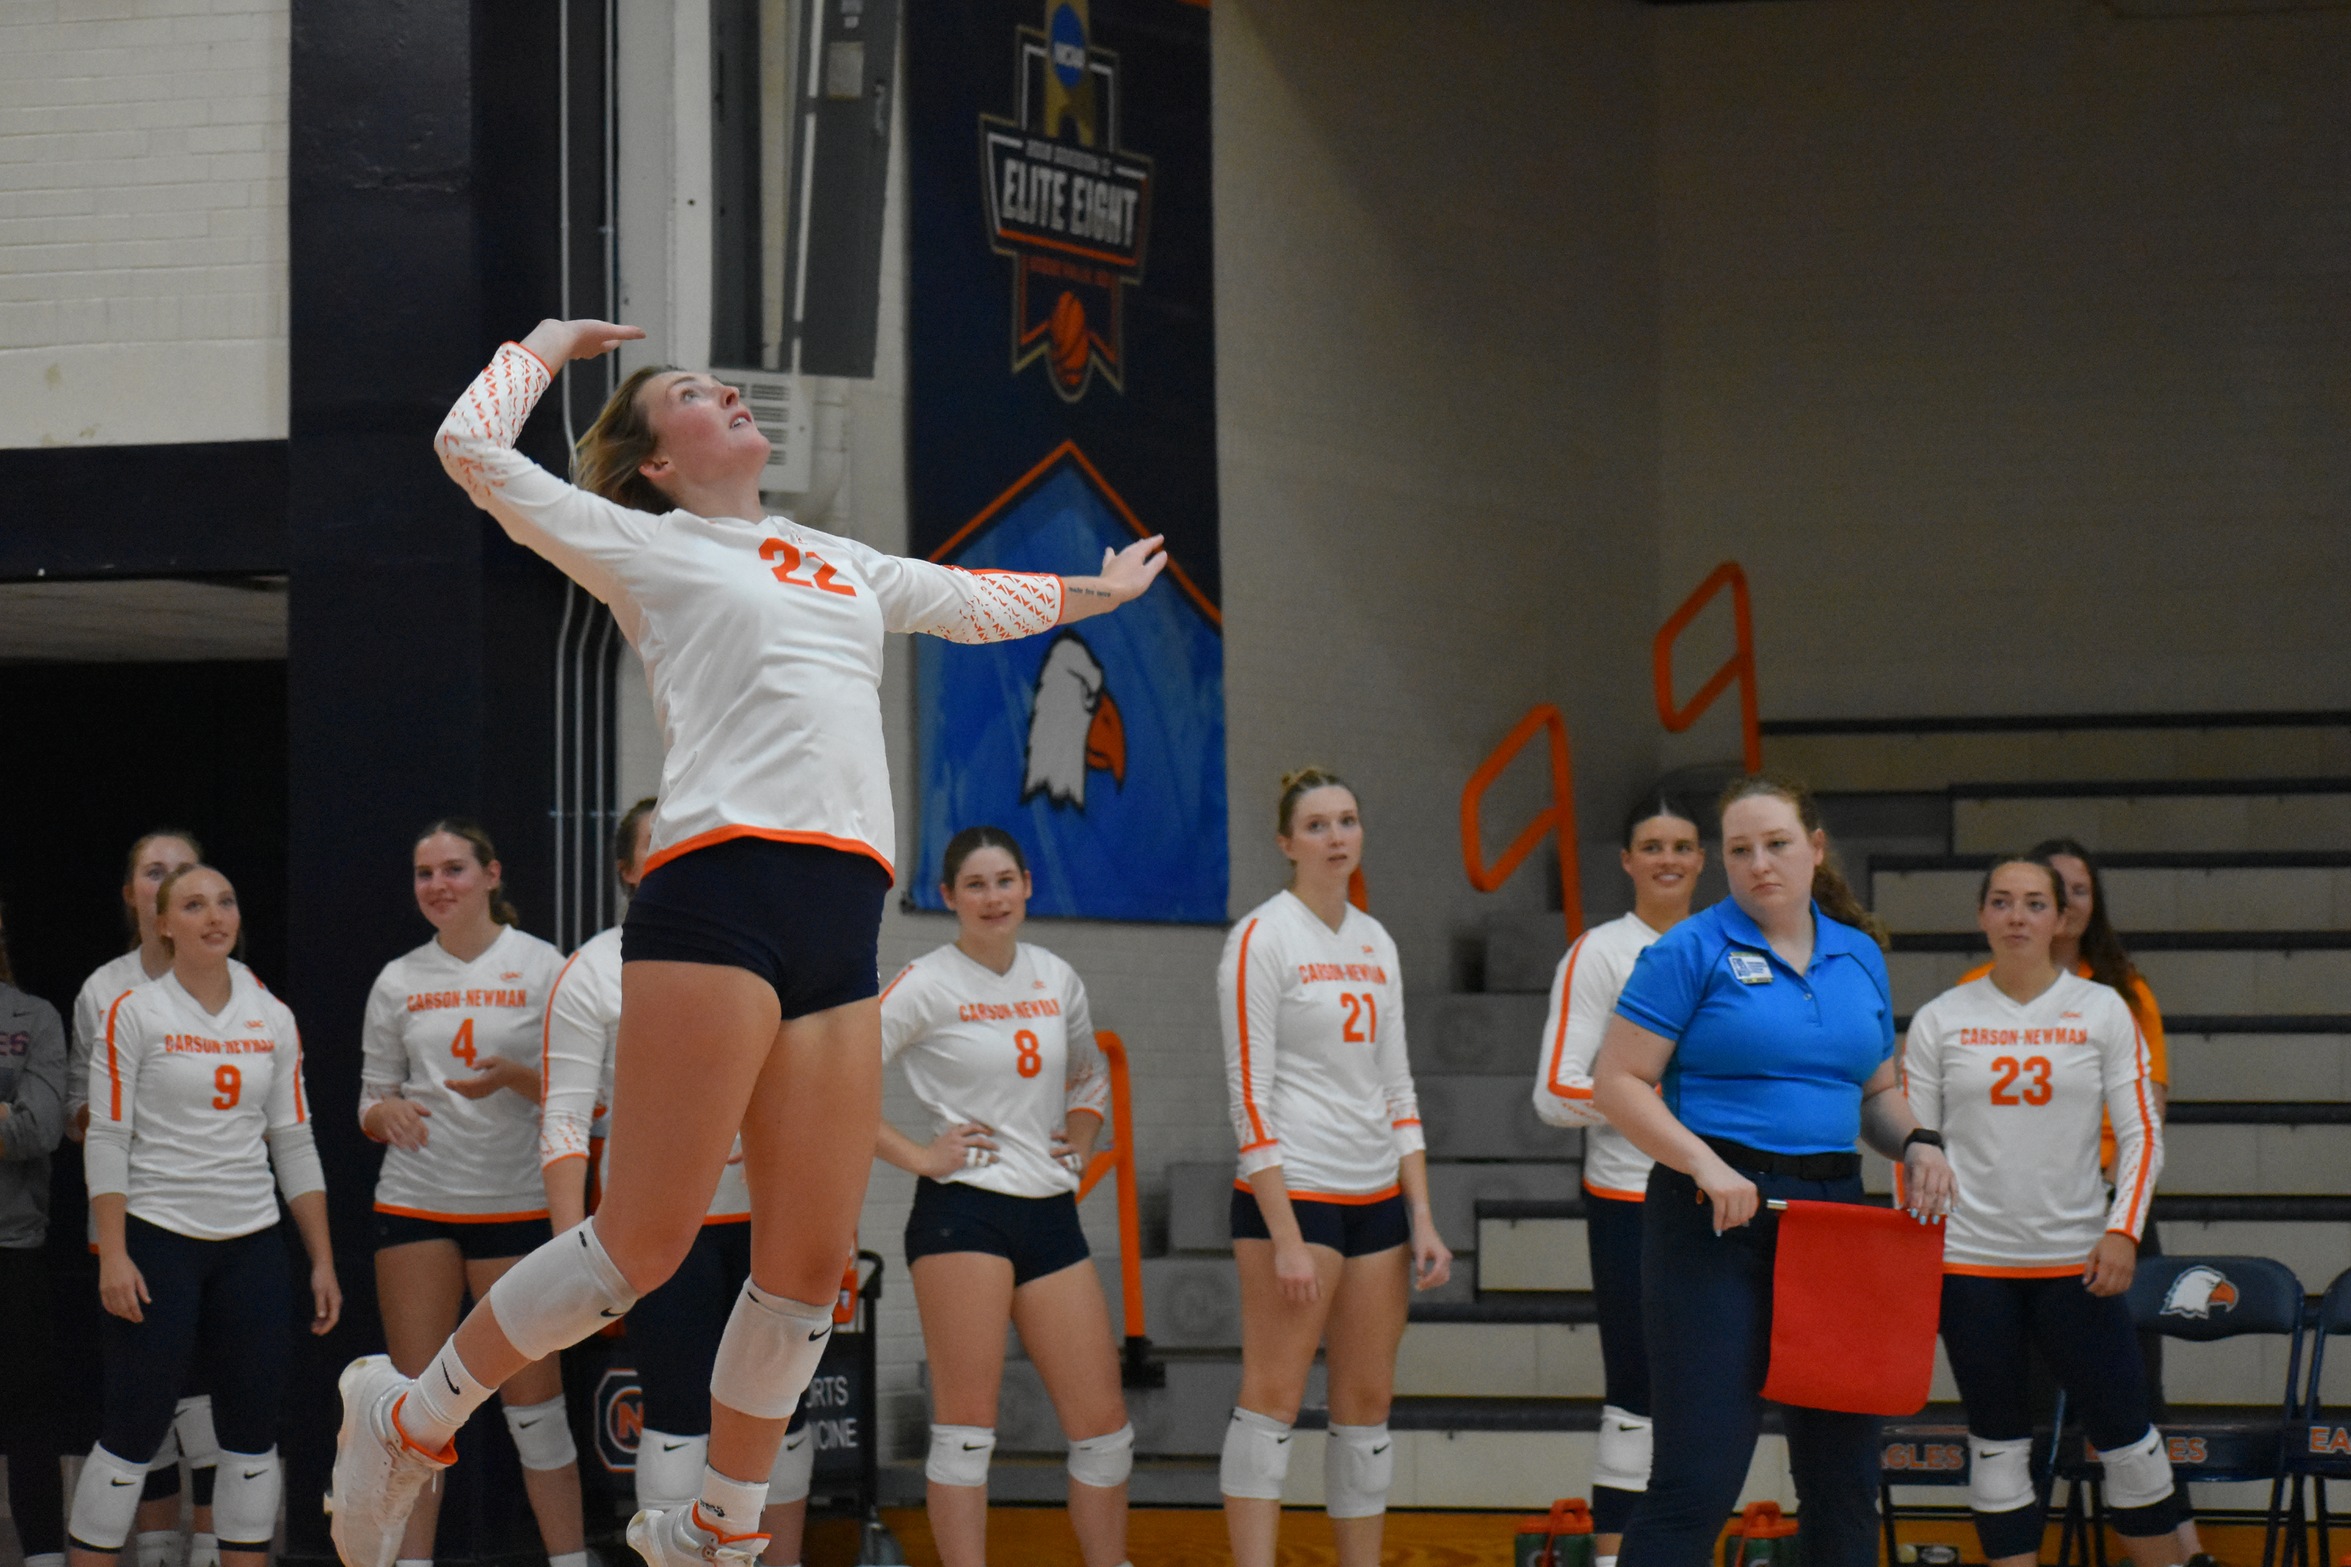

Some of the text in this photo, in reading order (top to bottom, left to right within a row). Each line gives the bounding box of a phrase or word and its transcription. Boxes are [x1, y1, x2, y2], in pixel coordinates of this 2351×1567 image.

[1002, 158, 1138, 248] ELITE EIGHT
[758, 537, 857, 597] 22
[406, 989, 526, 1012] CARSON-NEWMAN
[1340, 992, 1377, 1043] 21
[451, 1017, 477, 1068] 4
[1013, 1029, 1042, 1078] 8
[1960, 1027, 2087, 1045] CARSON-NEWMAN
[212, 1064, 241, 1111] 9
[1990, 1055, 2053, 1106] 23
[805, 1375, 849, 1408] RTS
[814, 1418, 859, 1450] ONE
[1882, 1443, 1965, 1470] GLES
